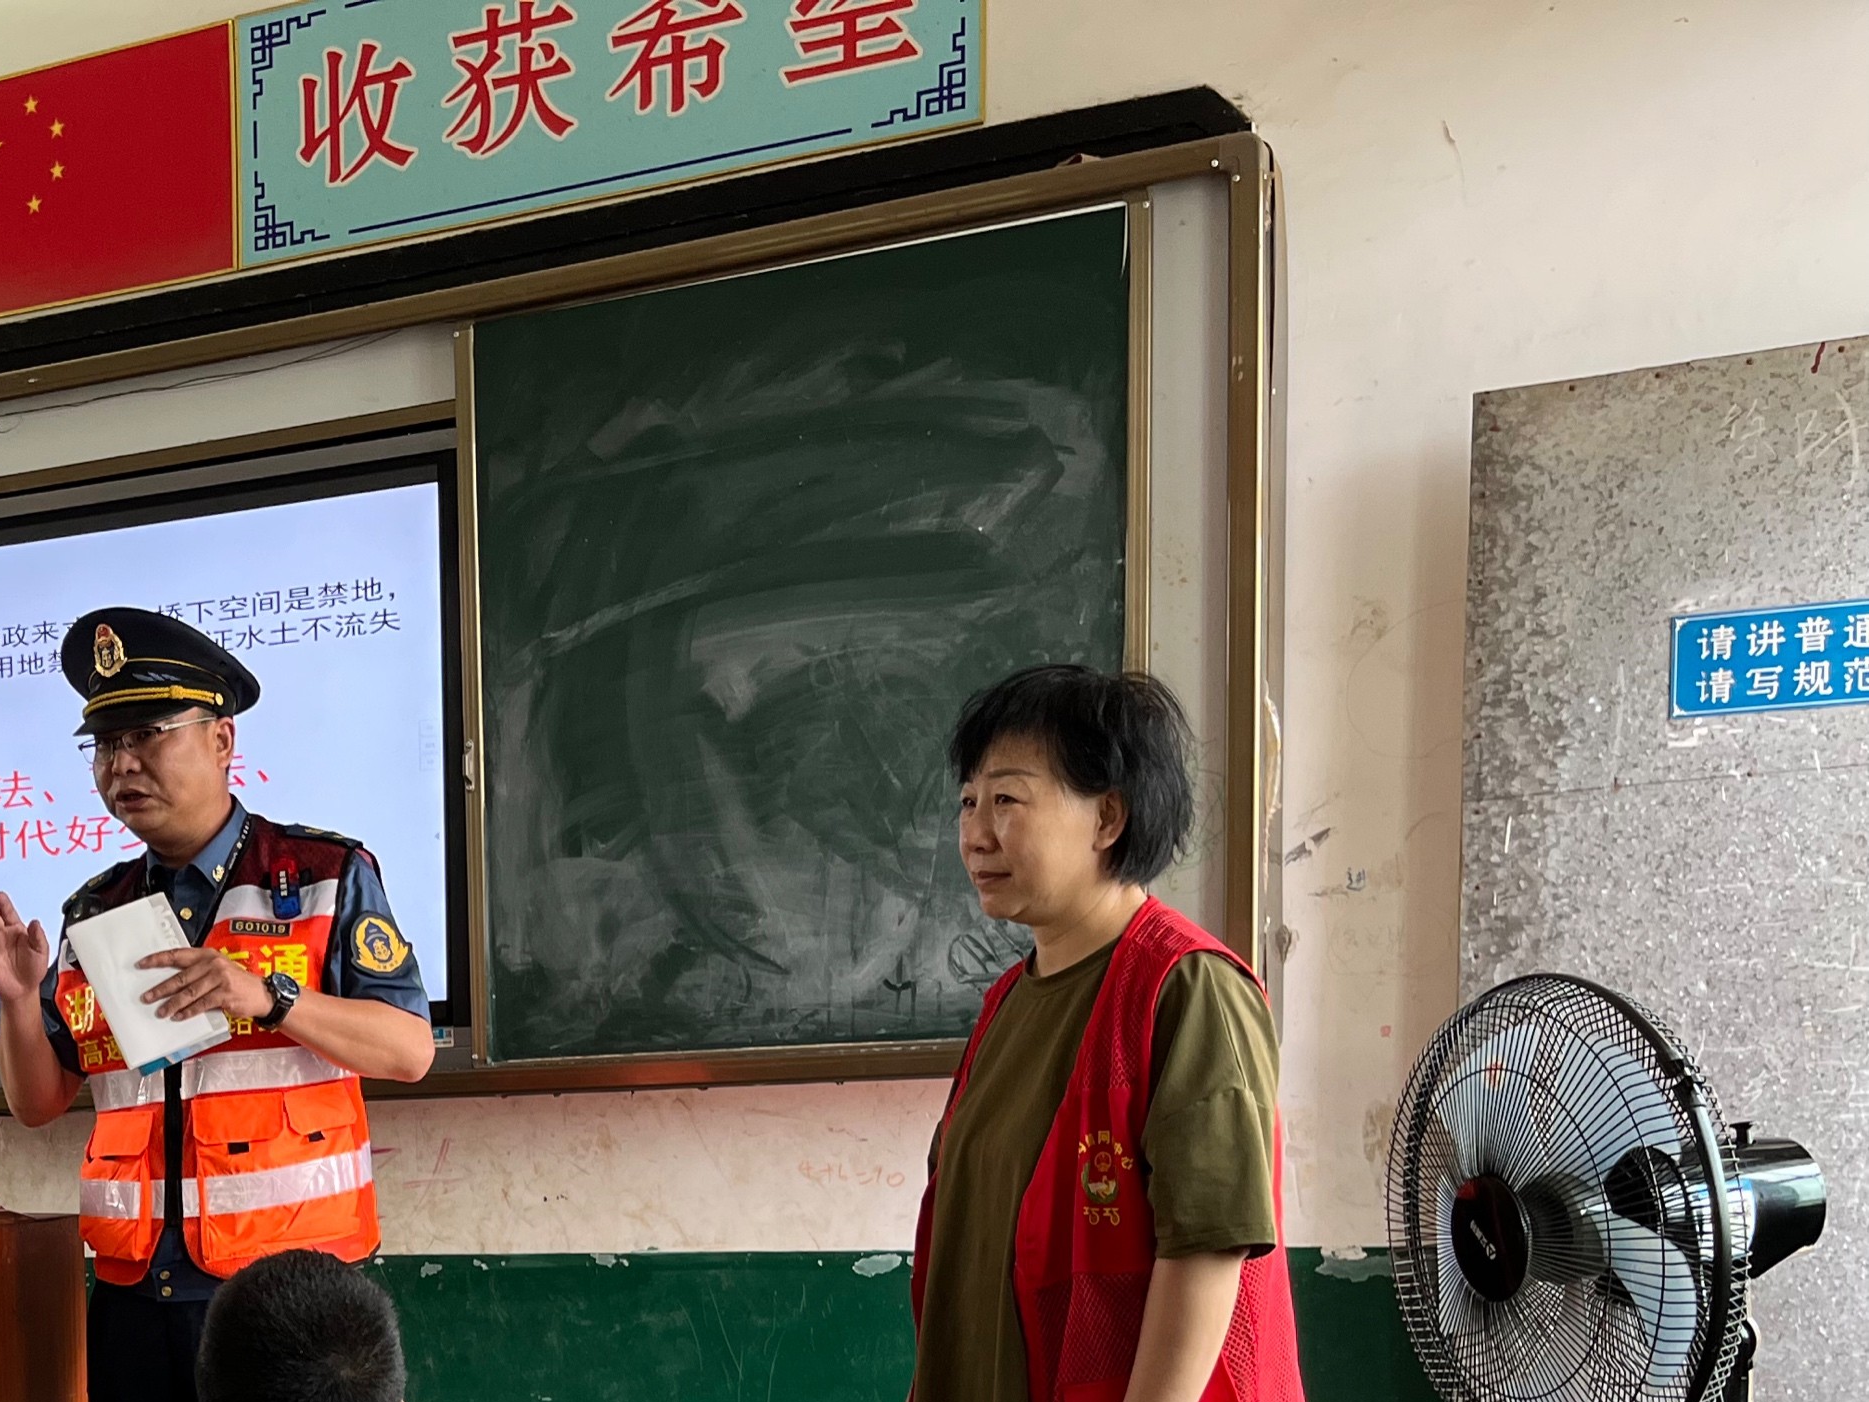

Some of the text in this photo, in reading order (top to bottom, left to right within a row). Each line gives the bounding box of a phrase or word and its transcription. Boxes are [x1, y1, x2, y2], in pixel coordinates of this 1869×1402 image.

[1697, 615, 1869, 661] 请讲普通
[1696, 657, 1869, 704] 请写规范
[234, 920, 286, 934] 601019
